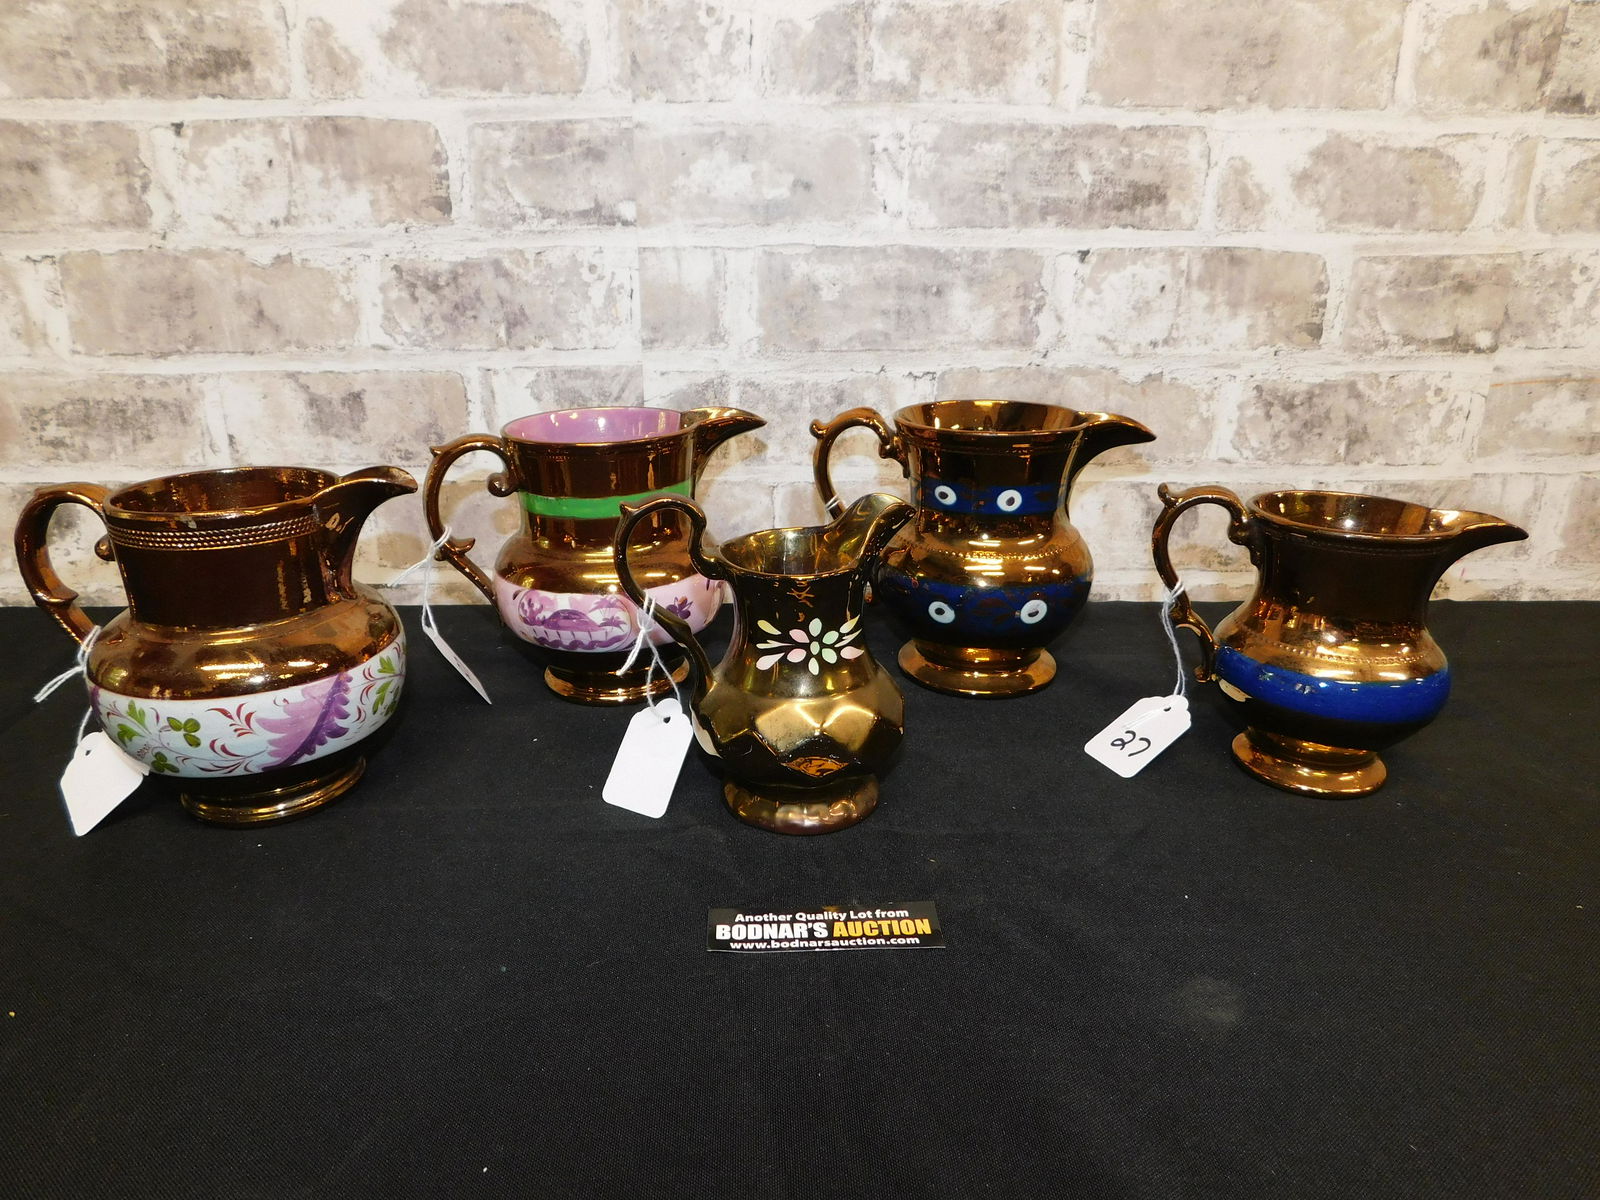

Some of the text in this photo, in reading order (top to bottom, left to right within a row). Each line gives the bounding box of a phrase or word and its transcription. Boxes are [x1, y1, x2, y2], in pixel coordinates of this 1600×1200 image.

[734, 909, 909, 922] Another Quality Lot from
[715, 918, 932, 940] BODNAR'S AUCTION
[729, 936, 920, 949] www.bodnarsauction.com
